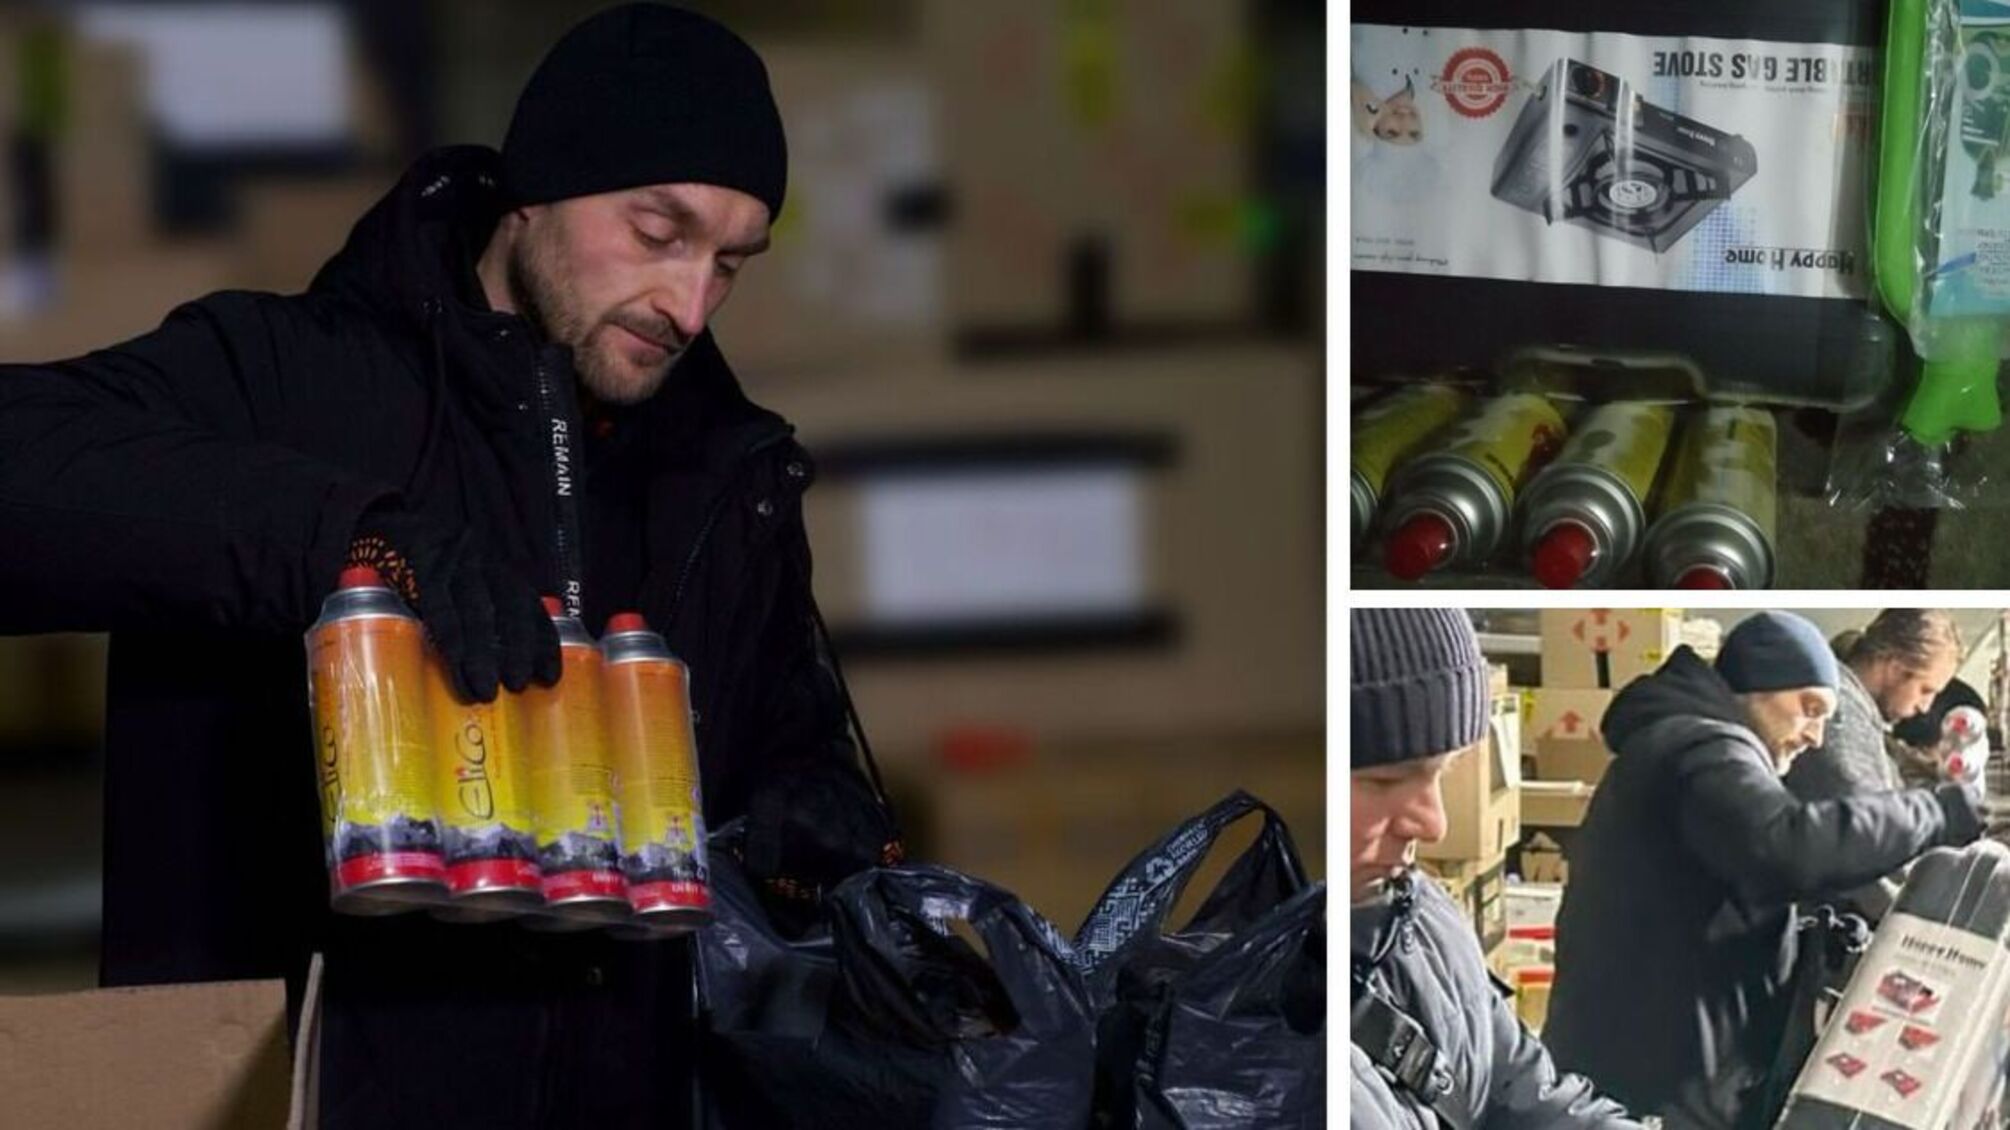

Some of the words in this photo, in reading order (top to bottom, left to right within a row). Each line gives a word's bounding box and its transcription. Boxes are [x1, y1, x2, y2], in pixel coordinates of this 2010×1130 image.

[1653, 51, 1724, 78] STOVE
[1731, 53, 1779, 82] GAS
[1725, 249, 1785, 271] Home
[551, 418, 572, 497] REMAIN
